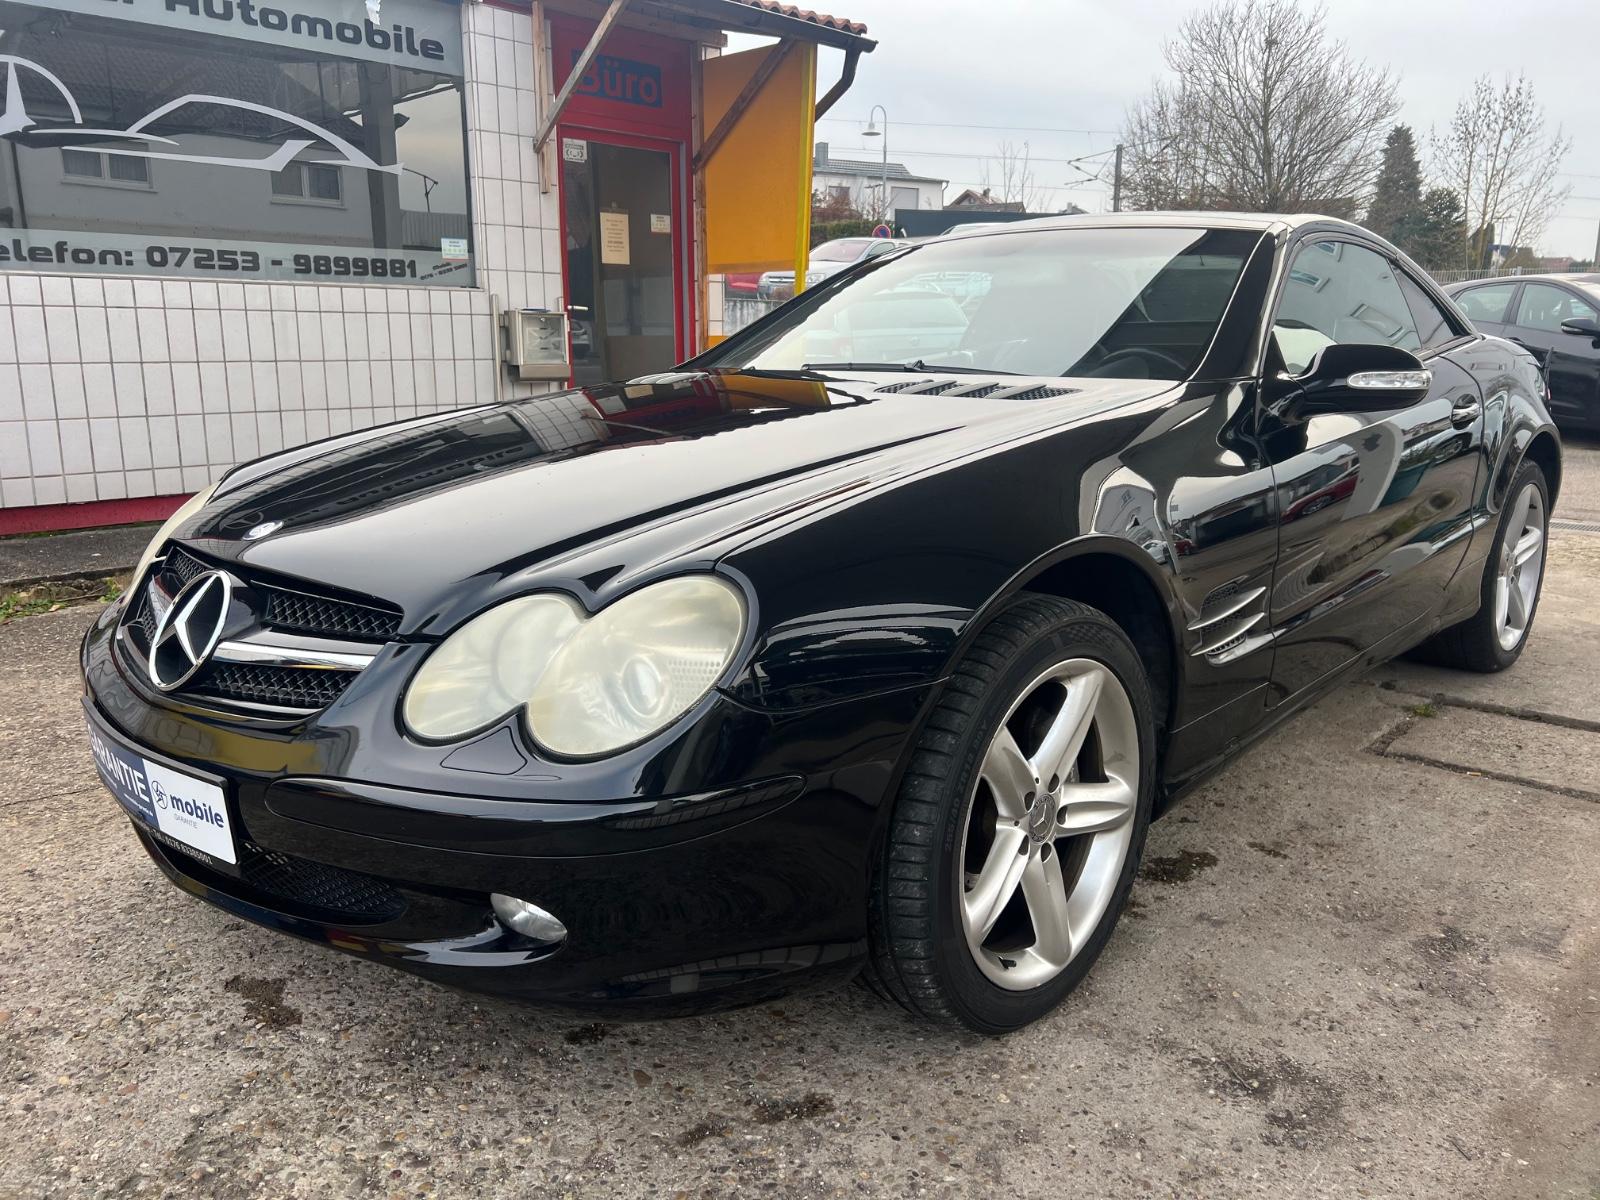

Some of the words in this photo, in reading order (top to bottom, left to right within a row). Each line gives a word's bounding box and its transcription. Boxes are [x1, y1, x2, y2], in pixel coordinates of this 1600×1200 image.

[165, 0, 445, 61] Automobile
[576, 58, 657, 103] Büro
[146, 245, 260, 272] 07253
[293, 254, 417, 278] 9899881
[170, 794, 225, 829] mobile
